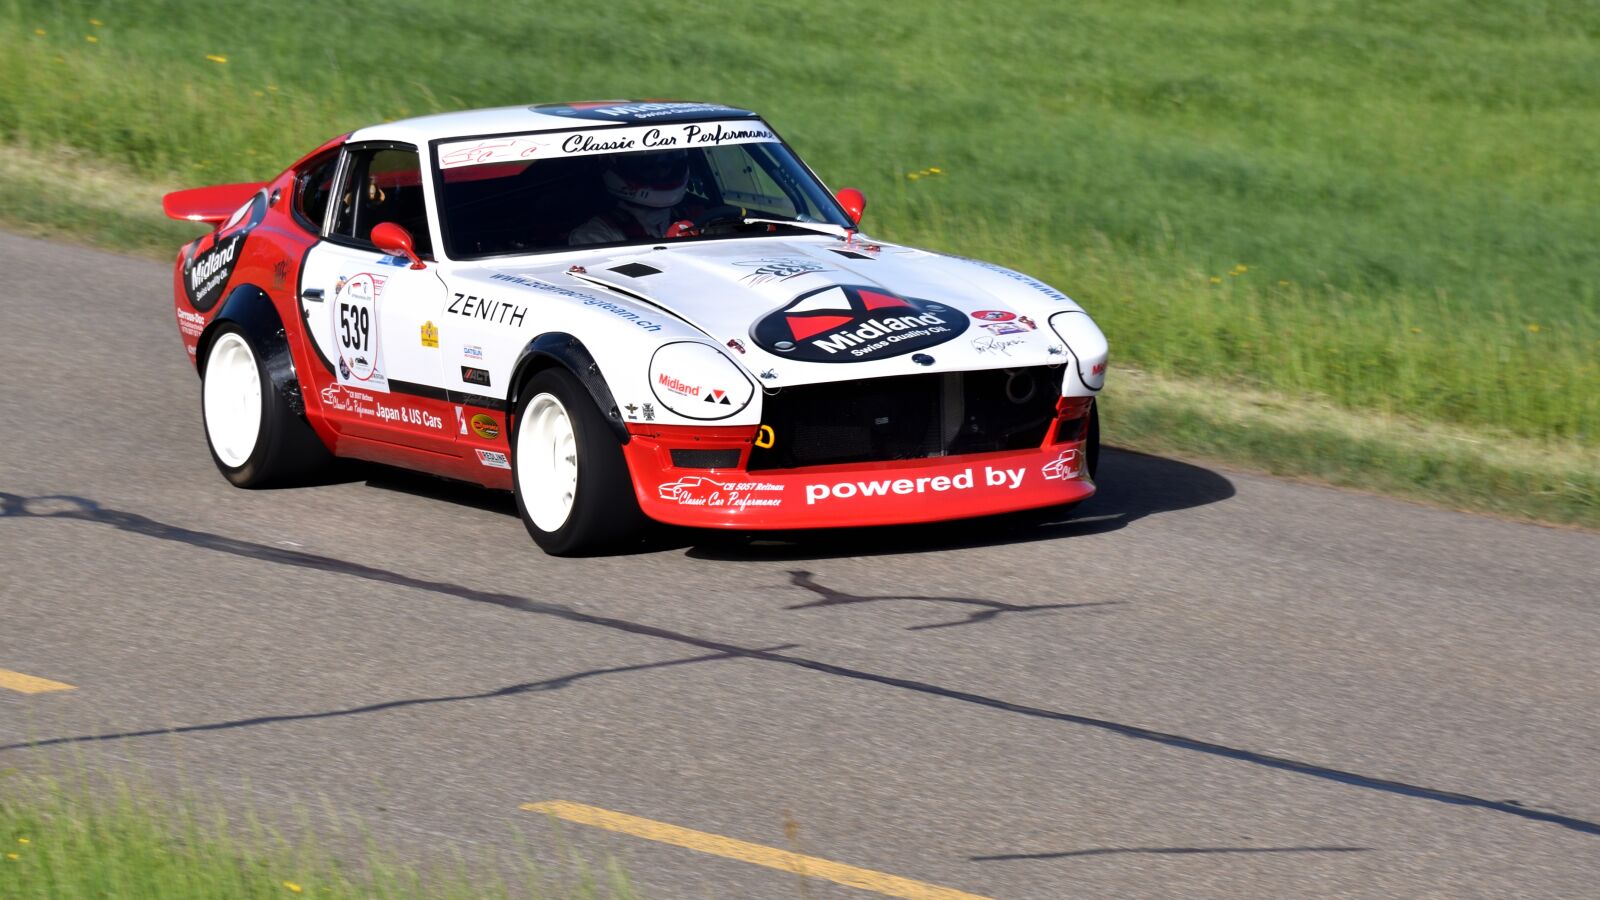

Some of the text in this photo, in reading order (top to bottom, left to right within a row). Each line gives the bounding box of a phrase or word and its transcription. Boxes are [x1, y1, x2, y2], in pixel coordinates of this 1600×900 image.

[561, 134, 636, 154] Classic
[642, 128, 677, 148] Car
[191, 237, 238, 291] Midland
[447, 292, 528, 327] ZENITH
[340, 303, 370, 352] 539
[812, 312, 947, 354] Midland
[850, 340, 890, 357] Swiss
[886, 329, 931, 343] Quality
[658, 373, 700, 397] Midland
[376, 402, 442, 429] Japan & US Cars
[482, 451, 507, 463] REDLINE
[805, 466, 1026, 505] powered by
[679, 490, 782, 511] Classic Car Performance
